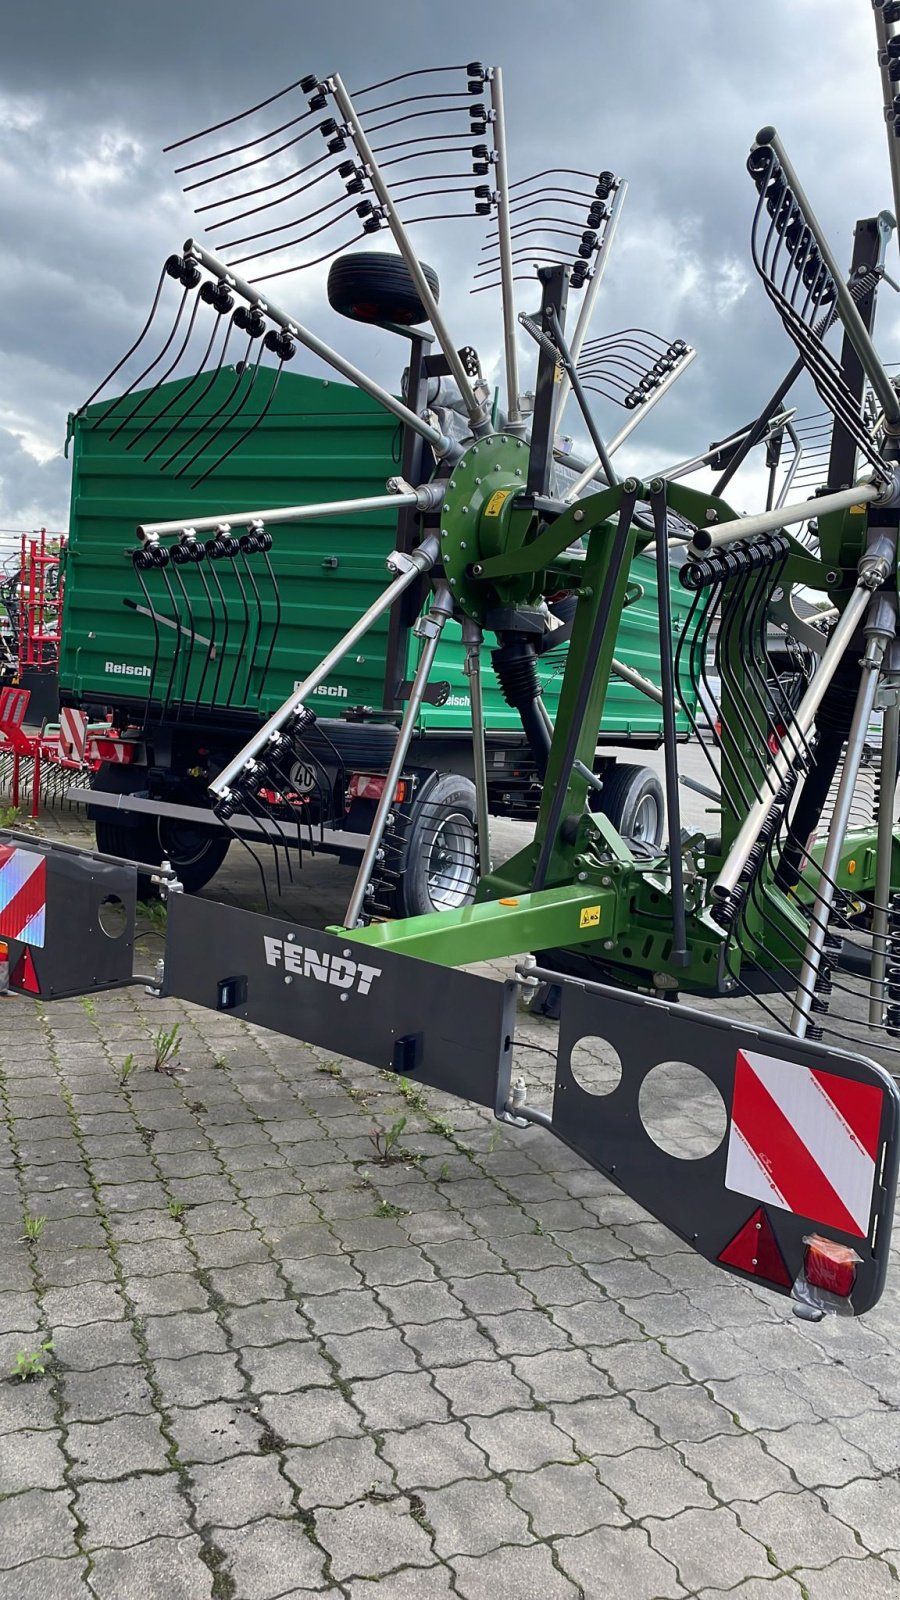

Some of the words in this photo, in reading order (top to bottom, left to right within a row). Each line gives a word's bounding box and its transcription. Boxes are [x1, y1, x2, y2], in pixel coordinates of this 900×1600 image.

[105, 661, 152, 677] Reisch
[444, 694, 470, 706] eisch
[294, 765, 313, 787] 40
[263, 935, 382, 995] FENDT
